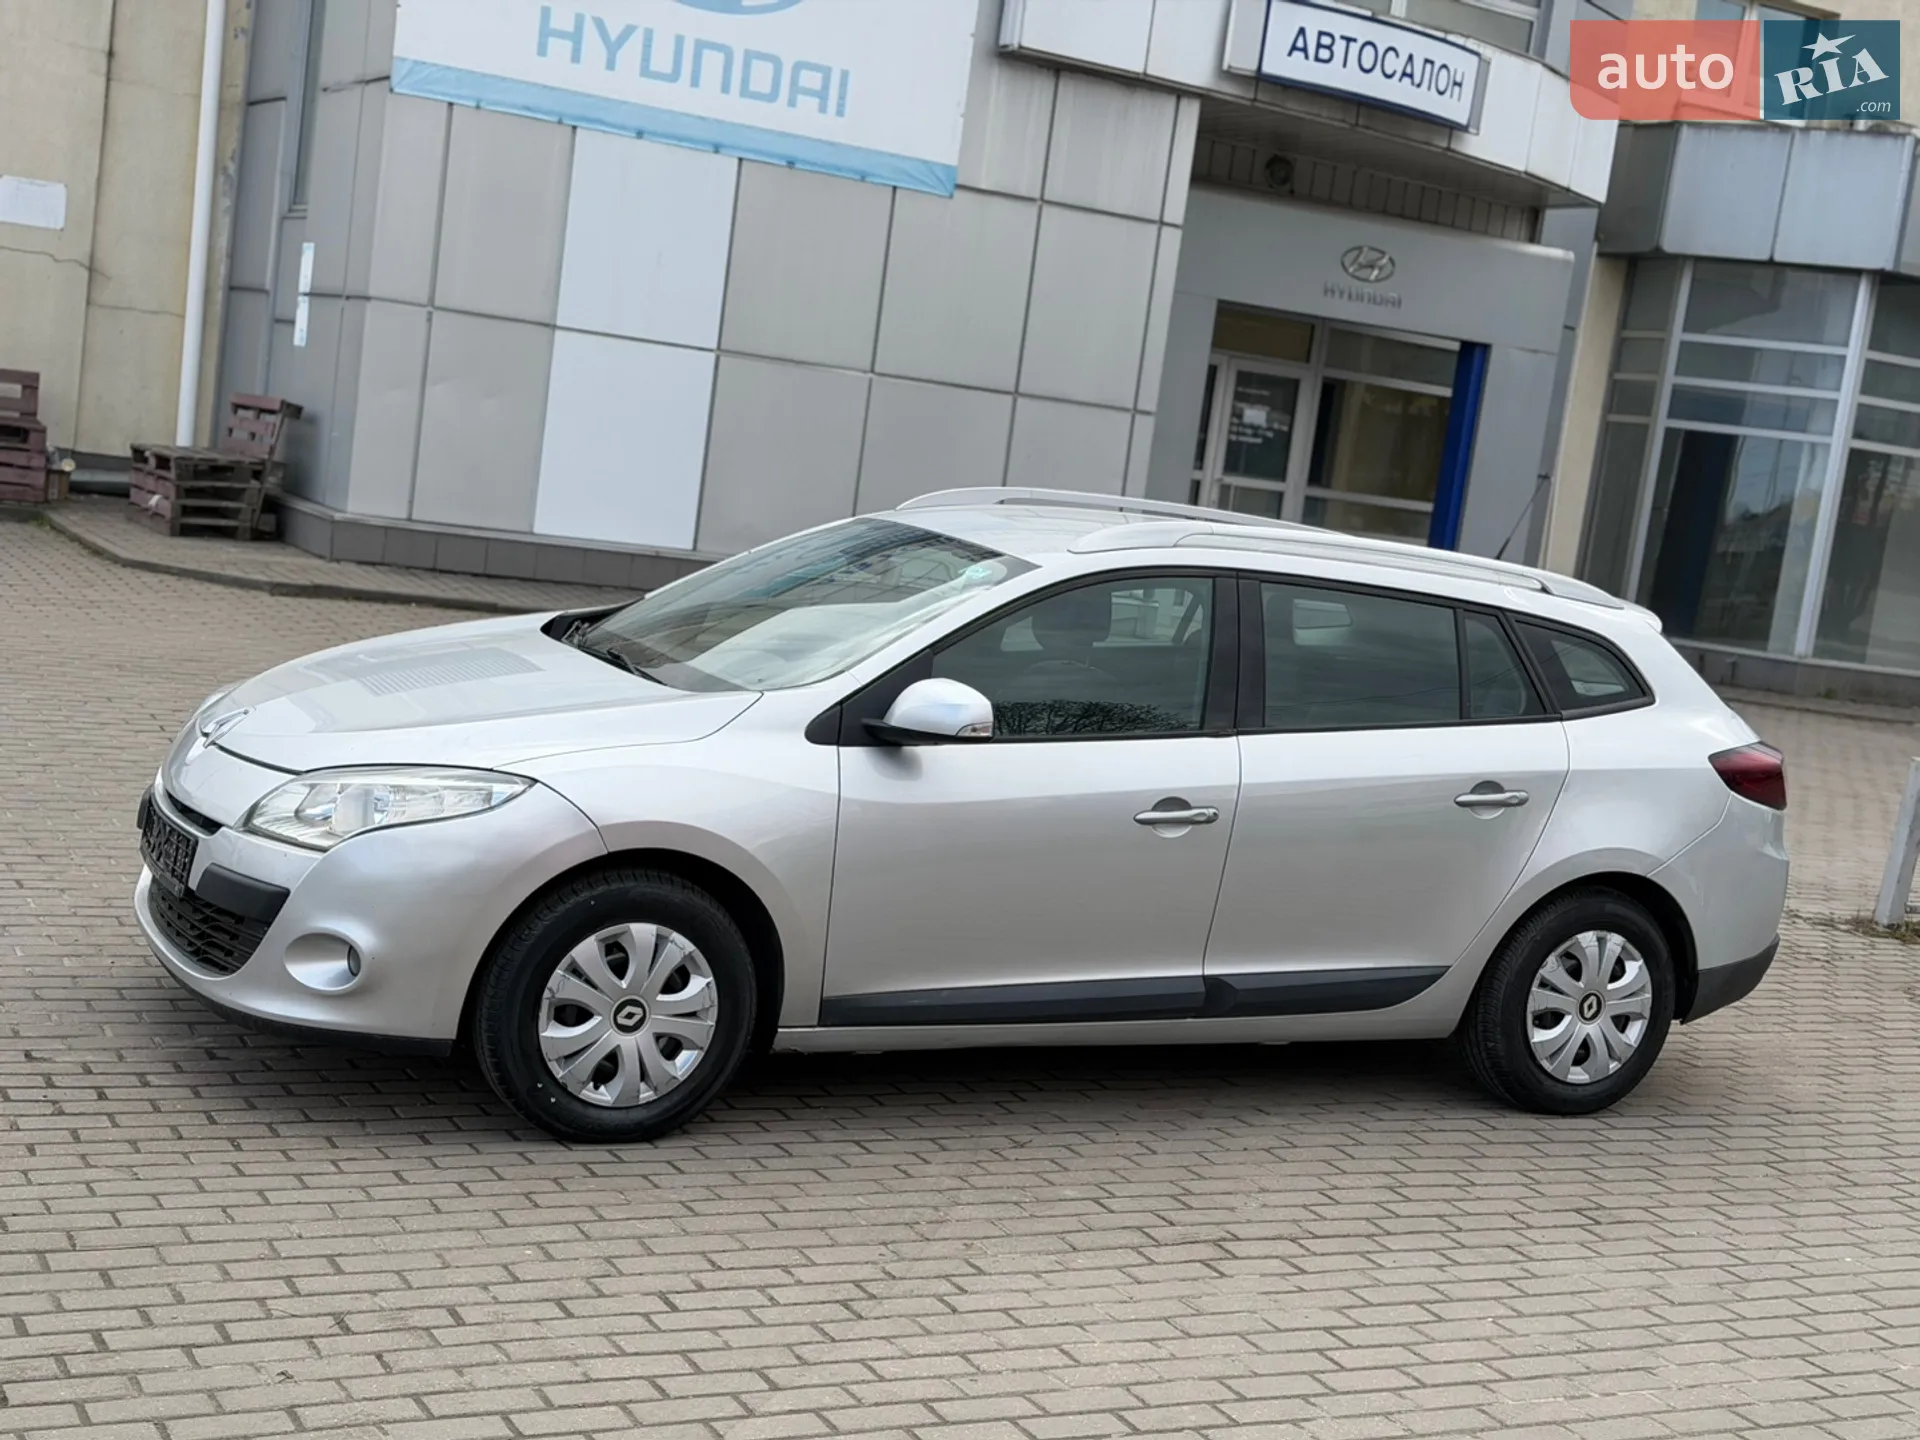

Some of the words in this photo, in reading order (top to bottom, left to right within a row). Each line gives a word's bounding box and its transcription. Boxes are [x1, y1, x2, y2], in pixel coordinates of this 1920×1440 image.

[537, 5, 850, 118] HYUNDAI
[1287, 26, 1465, 102] АВТОСАЛОН
[1323, 280, 1403, 310] HYUNDAI
